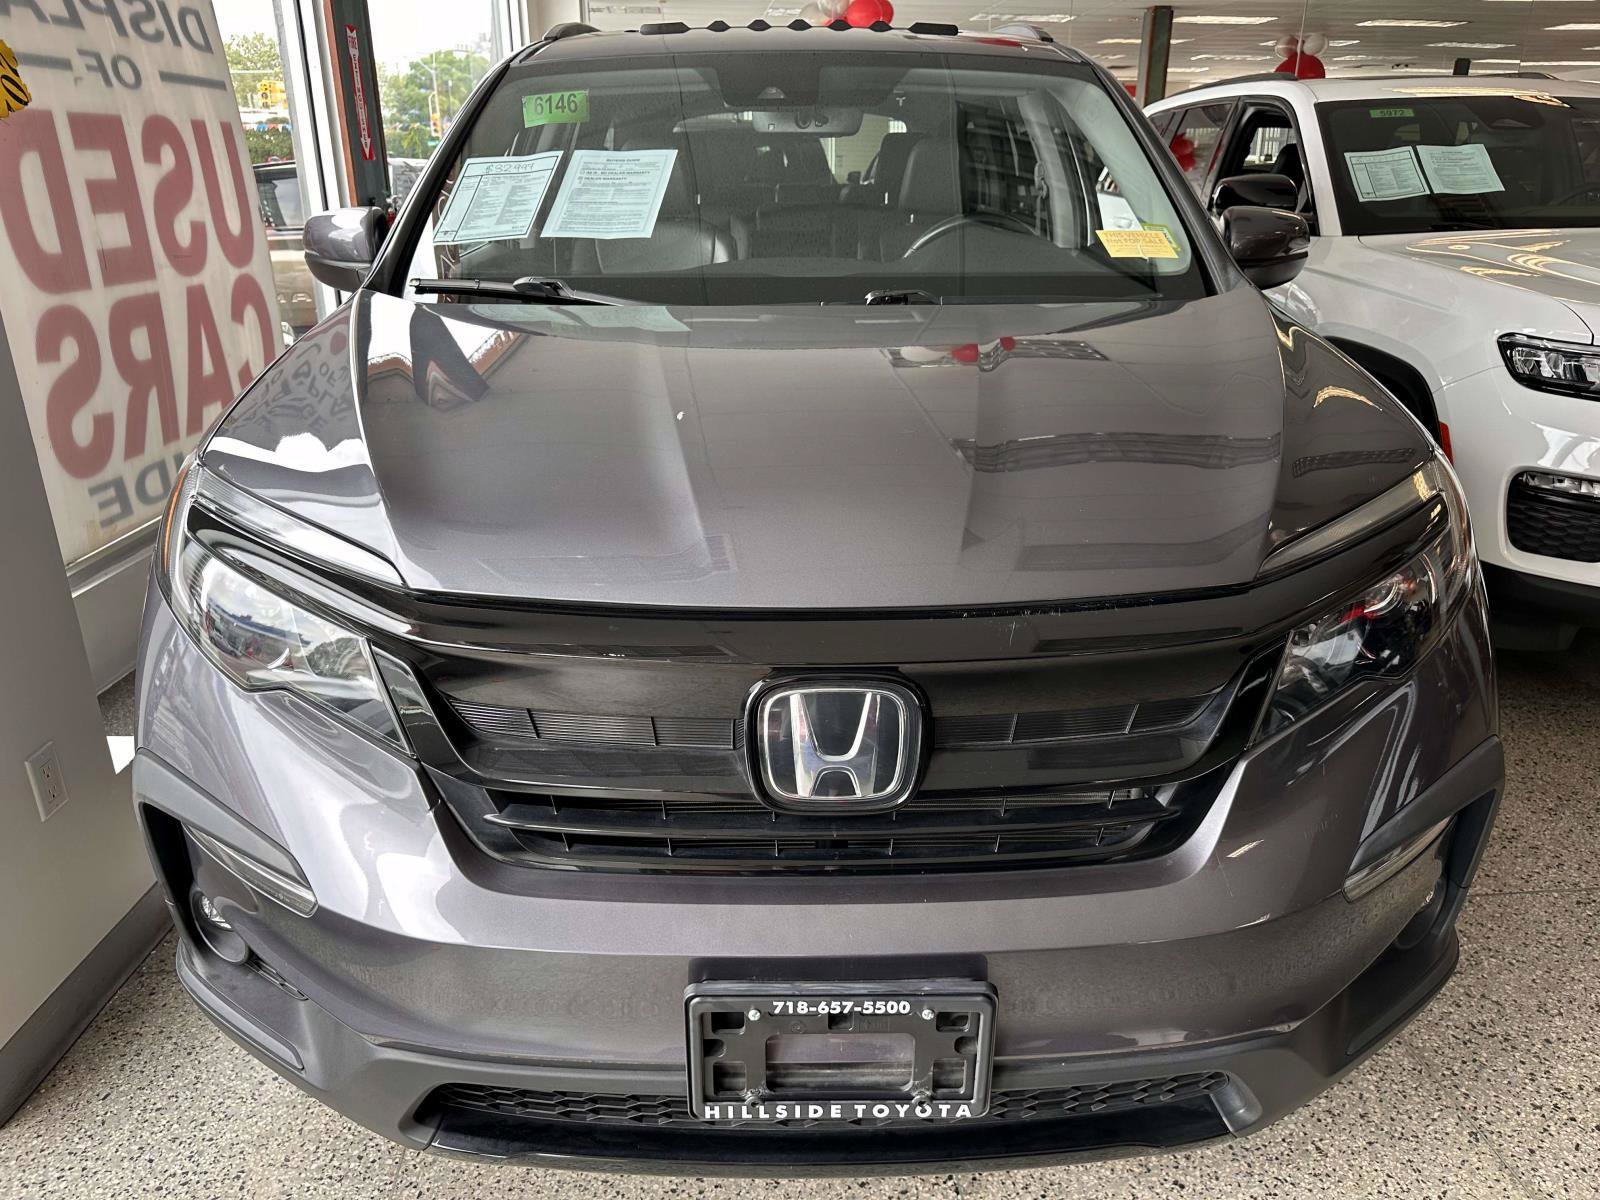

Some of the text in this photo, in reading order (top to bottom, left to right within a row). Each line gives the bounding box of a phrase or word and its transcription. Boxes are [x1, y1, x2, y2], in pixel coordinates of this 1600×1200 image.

[533, 92, 579, 116] 6146
[772, 1001, 911, 1015] 718-657-5500
[704, 1104, 972, 1119] HILLSIDE TOYOTA
